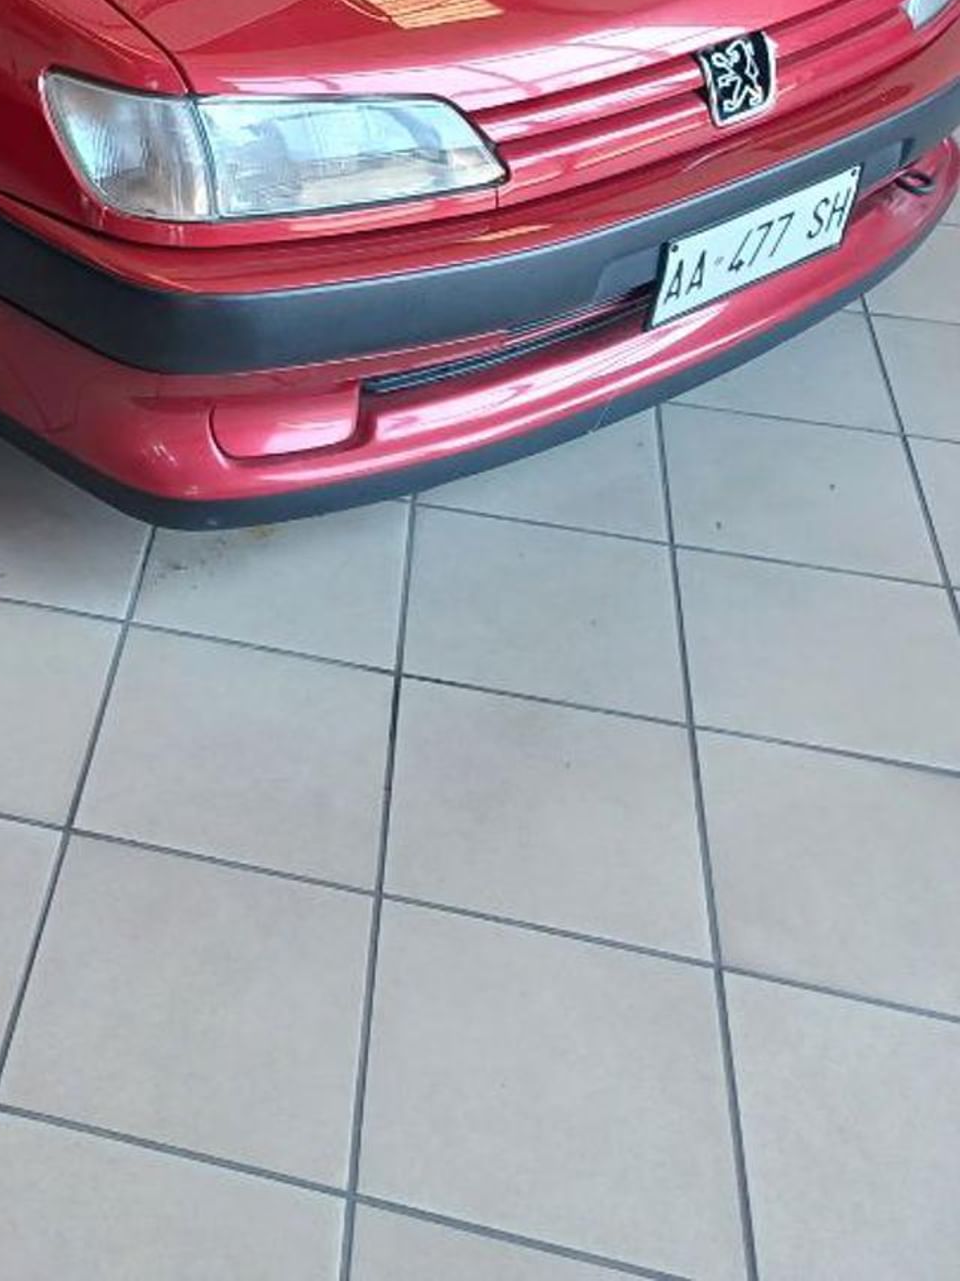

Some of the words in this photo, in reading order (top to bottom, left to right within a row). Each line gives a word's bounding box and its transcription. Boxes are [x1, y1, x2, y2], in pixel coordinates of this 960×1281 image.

[664, 250, 707, 305] AA
[728, 211, 796, 272] 477
[806, 186, 852, 240] SH
